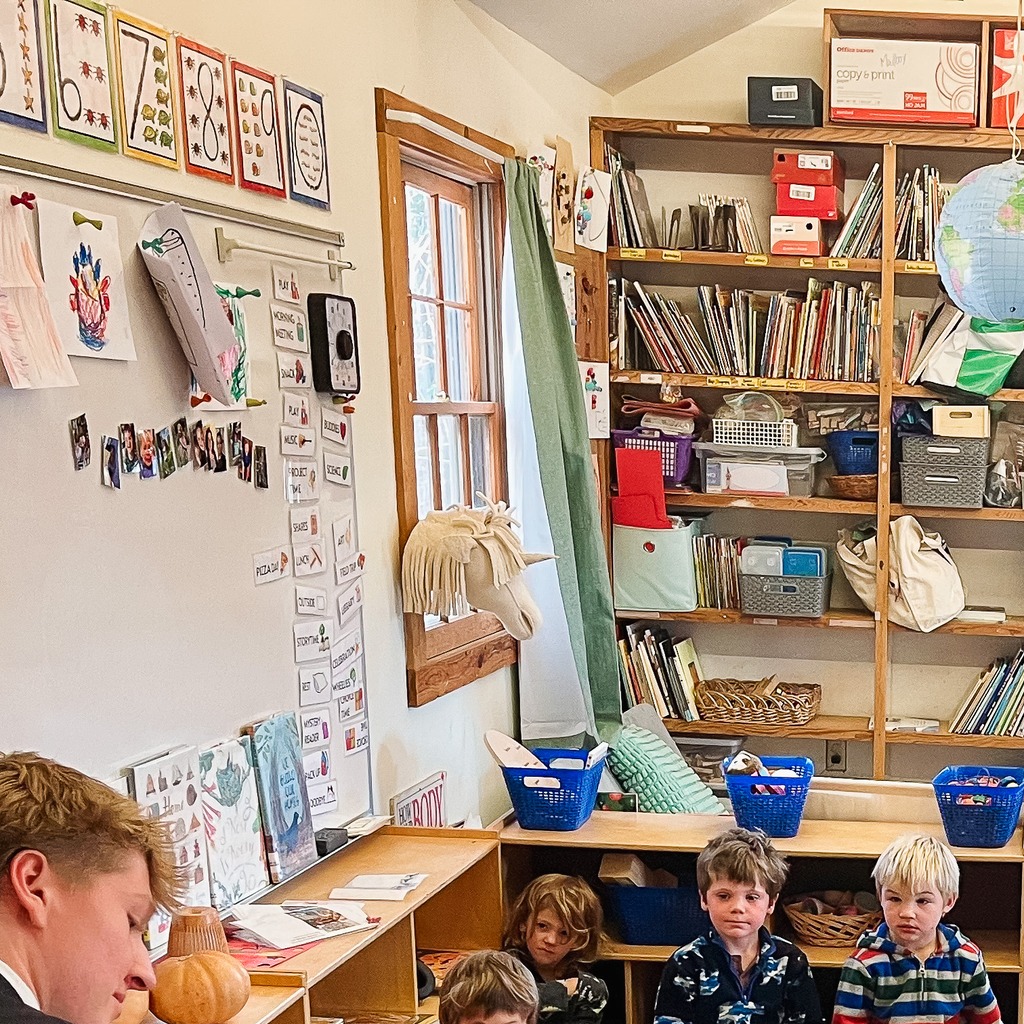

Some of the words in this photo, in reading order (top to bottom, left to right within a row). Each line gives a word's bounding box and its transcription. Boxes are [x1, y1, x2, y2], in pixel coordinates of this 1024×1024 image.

[52, 3, 82, 121] 6
[121, 28, 150, 140] 7
[836, 70, 862, 81] copy
[864, 71, 870, 79] &
[871, 70, 895, 81] print
[197, 62, 219, 162] 8
[260, 88, 282, 183] 9
[288, 96, 325, 191] 10
[288, 405, 299, 416] PLAY
[256, 564, 271, 577] PIZZA
[412, 784, 443, 827] BODY
